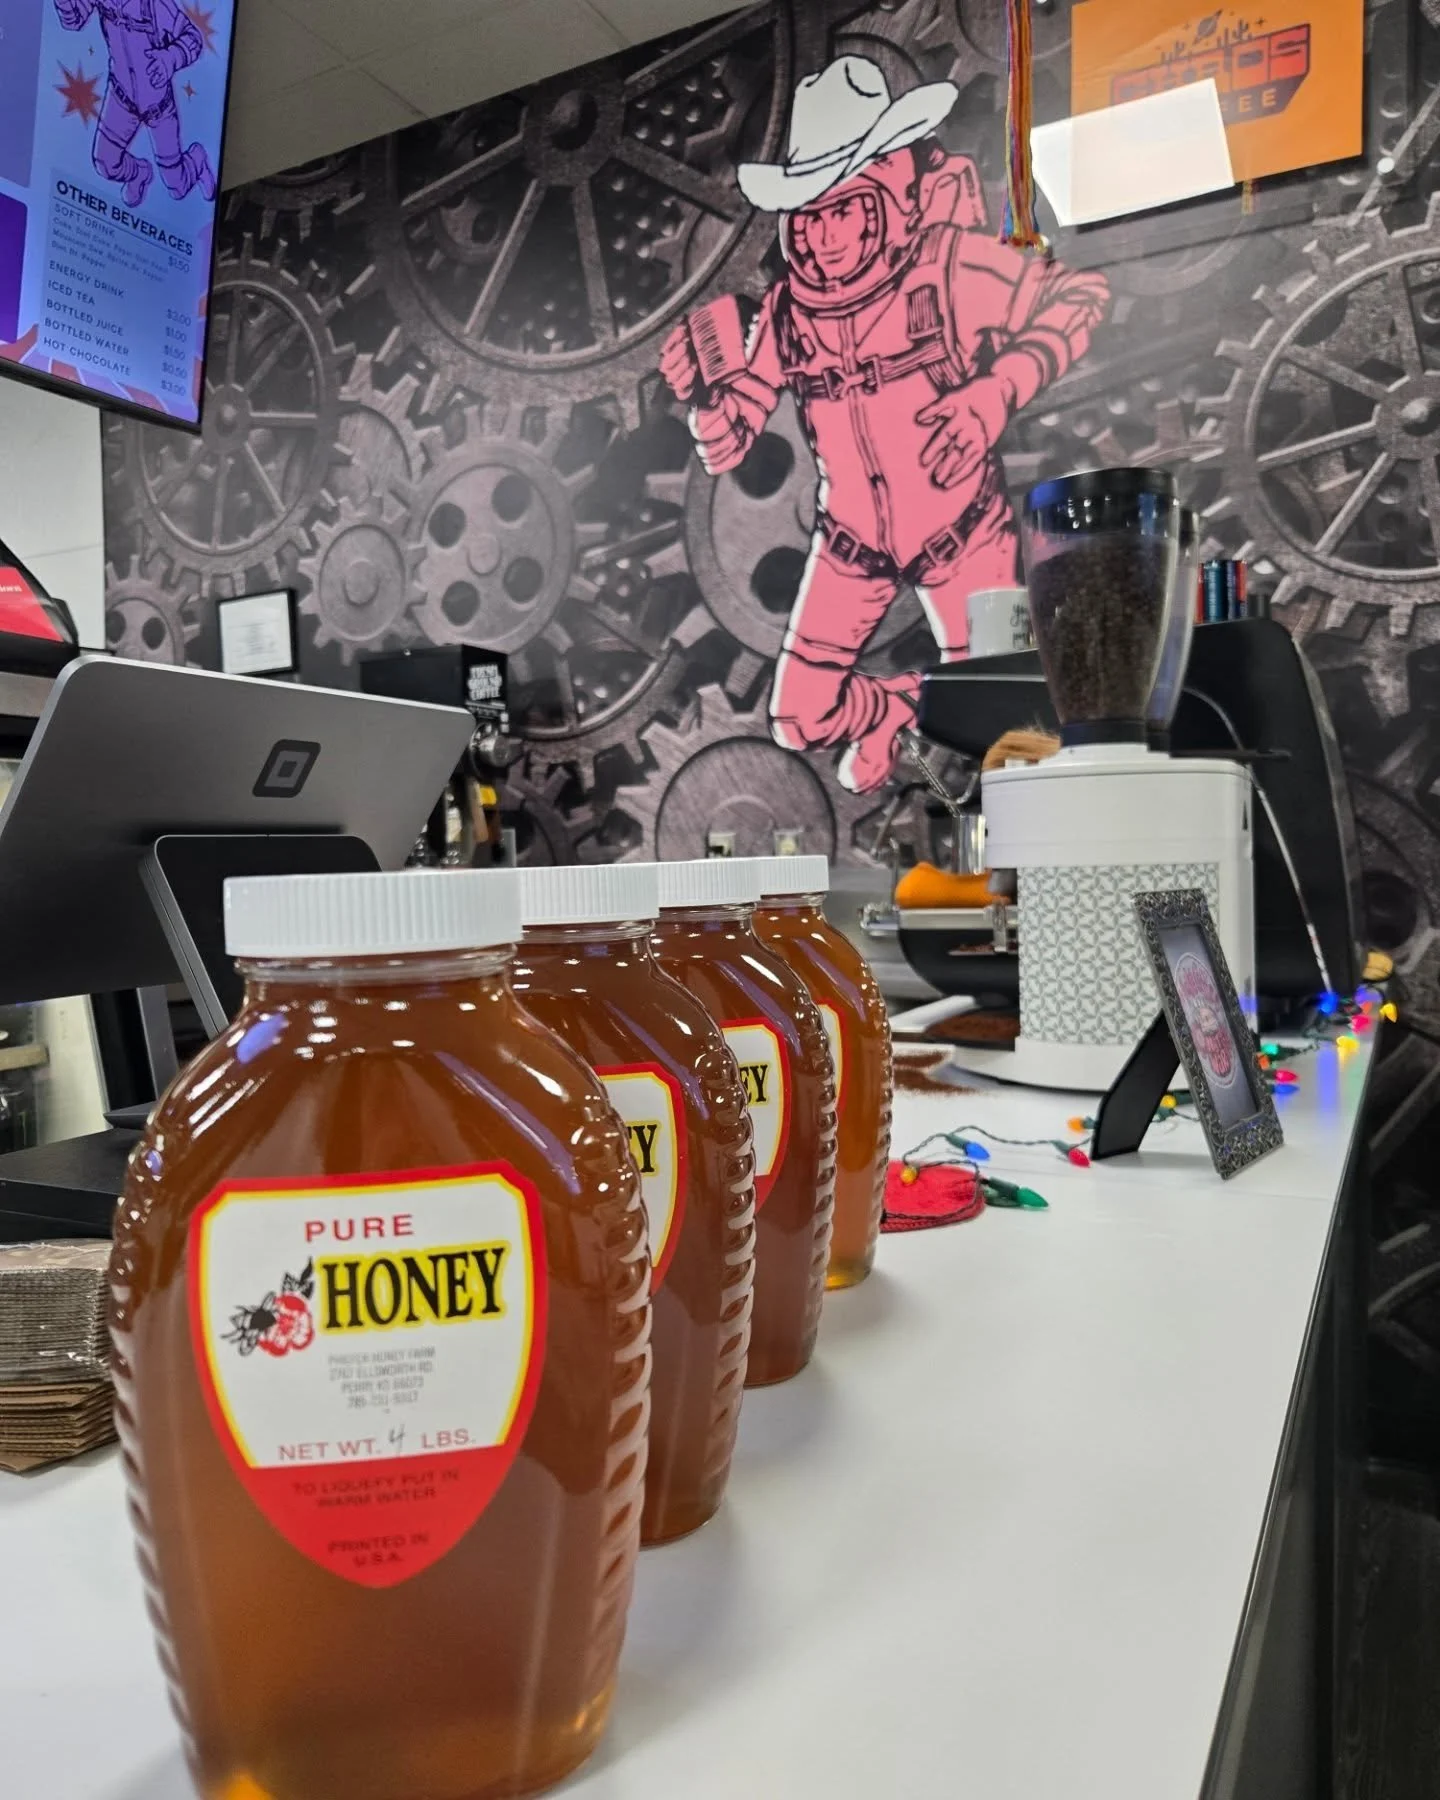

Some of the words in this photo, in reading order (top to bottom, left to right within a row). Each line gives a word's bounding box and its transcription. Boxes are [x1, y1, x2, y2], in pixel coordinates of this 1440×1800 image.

[54, 203, 81, 222] SOFT
[84, 217, 115, 238] DRINK
[56, 180, 107, 215] OTHER
[111, 206, 193, 256] BEVERAGES
[47, 280, 73, 297] ICED
[75, 290, 96, 306] TEA
[48, 260, 91, 283] ENERGY
[94, 280, 124, 299] DRINK
[46, 298, 94, 325] BOTTLED
[96, 318, 124, 337] JUICE
[44, 317, 92, 342] BOTTLED
[95, 335, 130, 357] WATER
[43, 337, 67, 352] HOT
[69, 346, 131, 376] CHOCOLATE
[304, 1214, 415, 1242] PURE
[322, 1247, 506, 1330] HONEY
[278, 1442, 328, 1460] NET
[337, 1438, 381, 1456] WT.
[388, 1424, 406, 1456] 4
[421, 1428, 476, 1449] LBS.
[293, 1481, 316, 1495] TO
[401, 1470, 434, 1485] PUT
[441, 1468, 460, 1481] IN
[377, 1487, 436, 1504] WATER
[328, 1535, 406, 1553] PRINTED
[411, 1533, 429, 1545] IN
